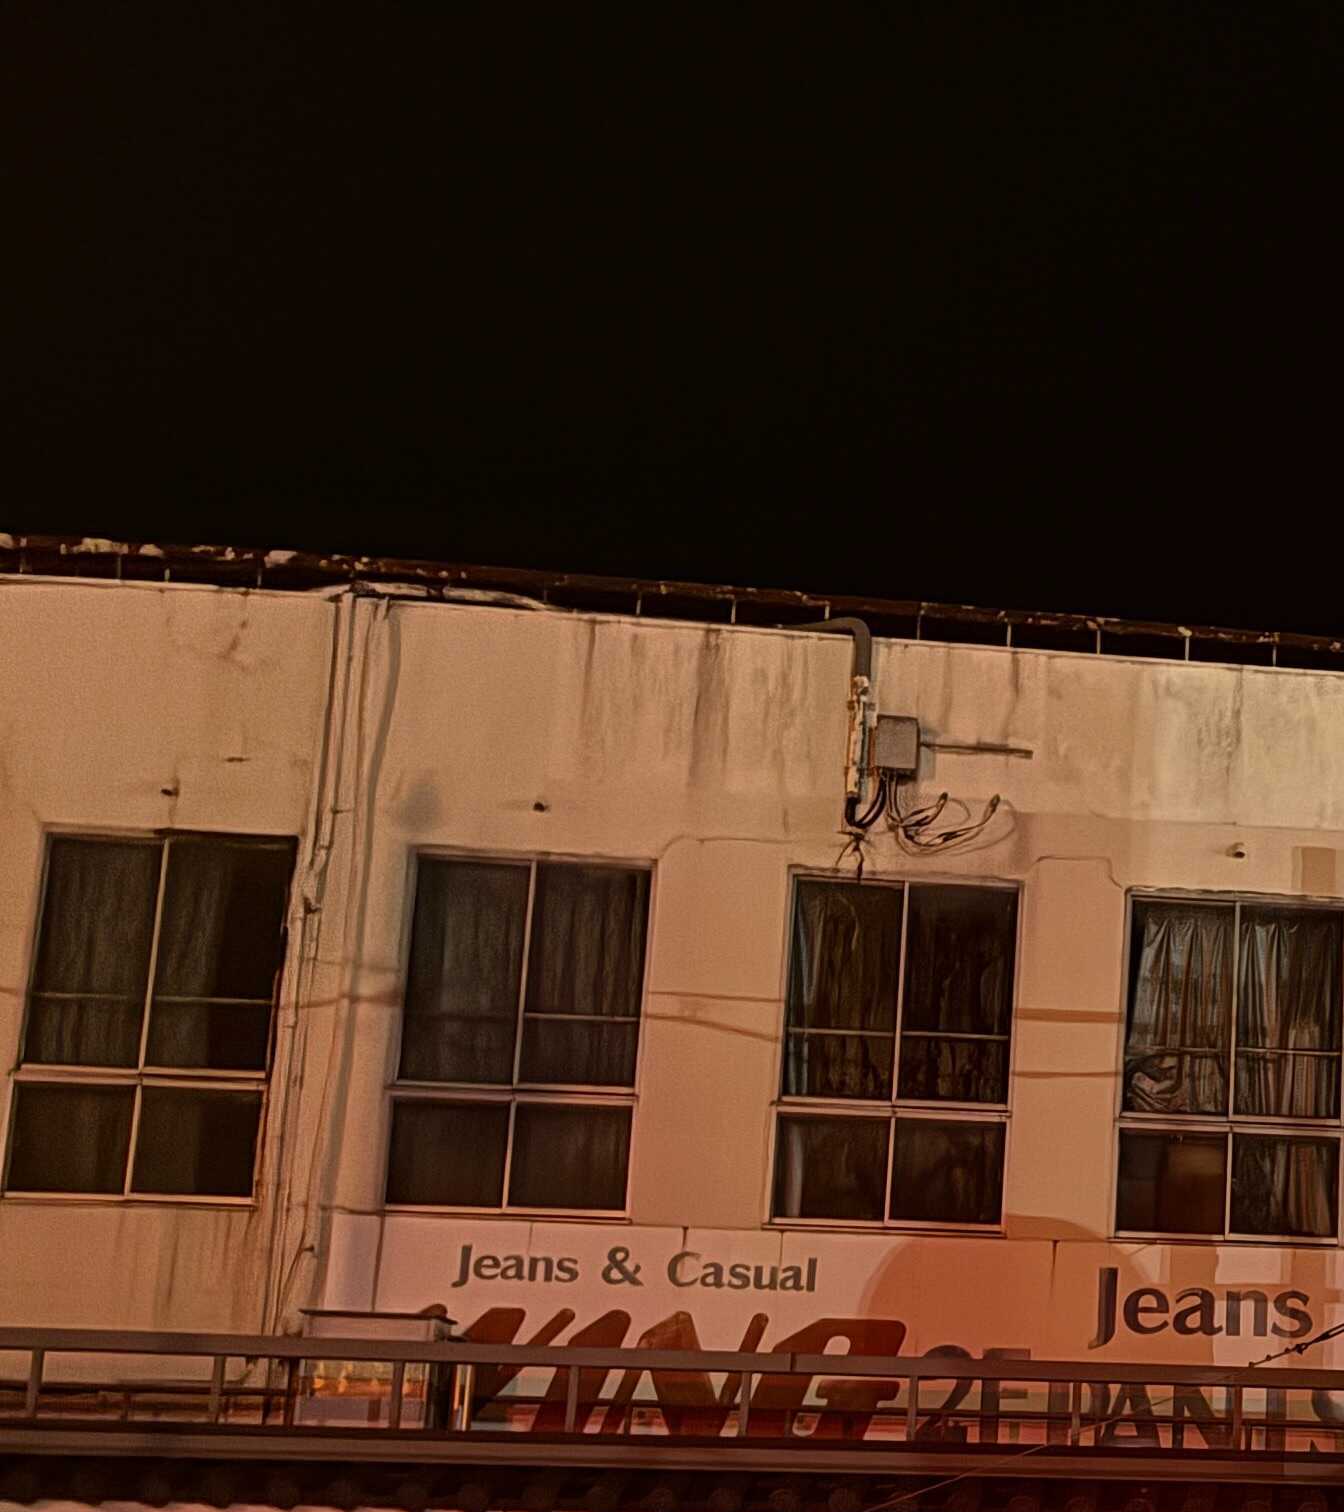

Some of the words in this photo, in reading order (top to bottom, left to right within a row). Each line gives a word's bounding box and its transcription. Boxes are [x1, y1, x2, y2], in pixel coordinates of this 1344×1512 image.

[451, 1244, 580, 1289] Jeans
[600, 1245, 644, 1287] &
[667, 1251, 819, 1293] Casual
[1088, 1266, 1314, 1350] Jeans
